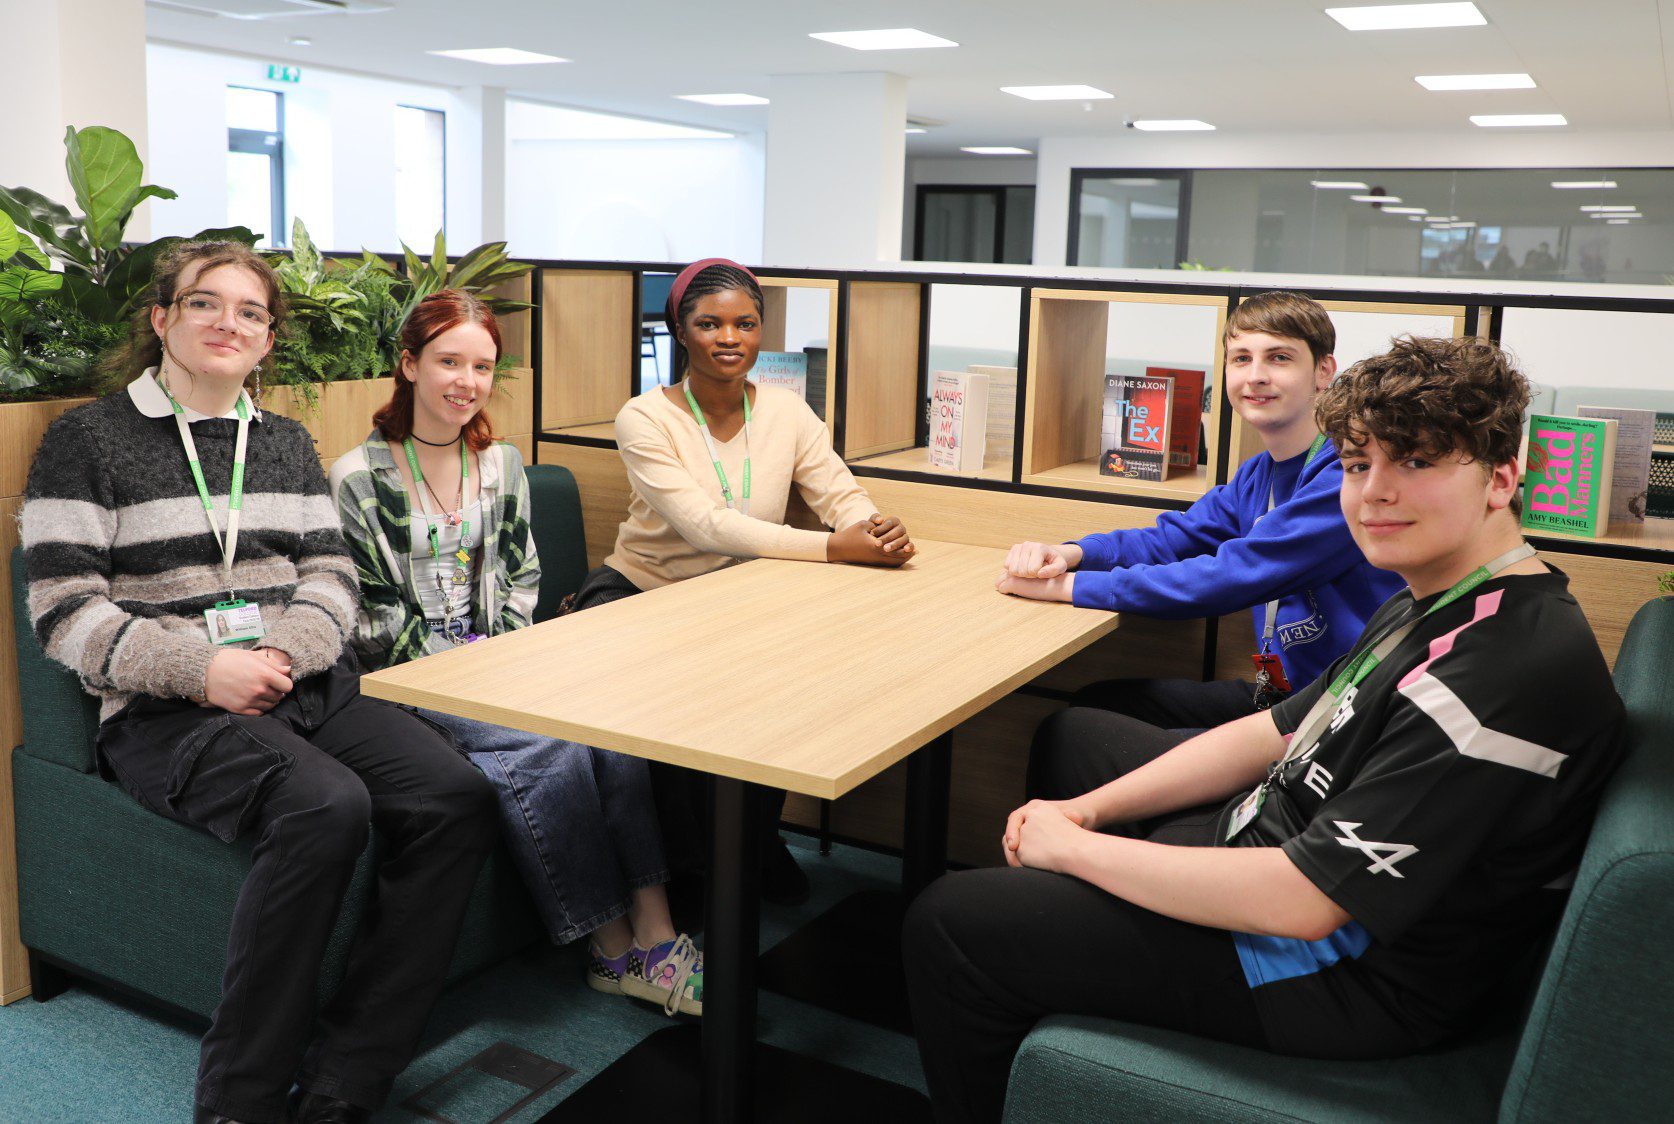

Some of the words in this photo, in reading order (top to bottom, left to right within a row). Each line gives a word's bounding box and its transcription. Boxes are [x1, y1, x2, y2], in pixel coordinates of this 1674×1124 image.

[768, 364, 790, 374] Girls
[758, 375, 795, 385] Bomber
[1109, 379, 1135, 389] DIANE
[1136, 381, 1166, 391] SAXON
[934, 388, 963, 406] ALWAYS
[940, 405, 954, 419] ON
[1115, 399, 1149, 419] The
[940, 421, 953, 435] MY
[1129, 418, 1160, 443] Ex
[935, 435, 956, 450] MIND
[1530, 429, 1576, 516] Bad
[1570, 433, 1595, 519] Manners
[1528, 513, 1547, 522] AMY
[1549, 516, 1589, 529] BEASHEL
[1458, 570, 1489, 592] COUNCIL
[1333, 667, 1353, 693] COUNCIL
